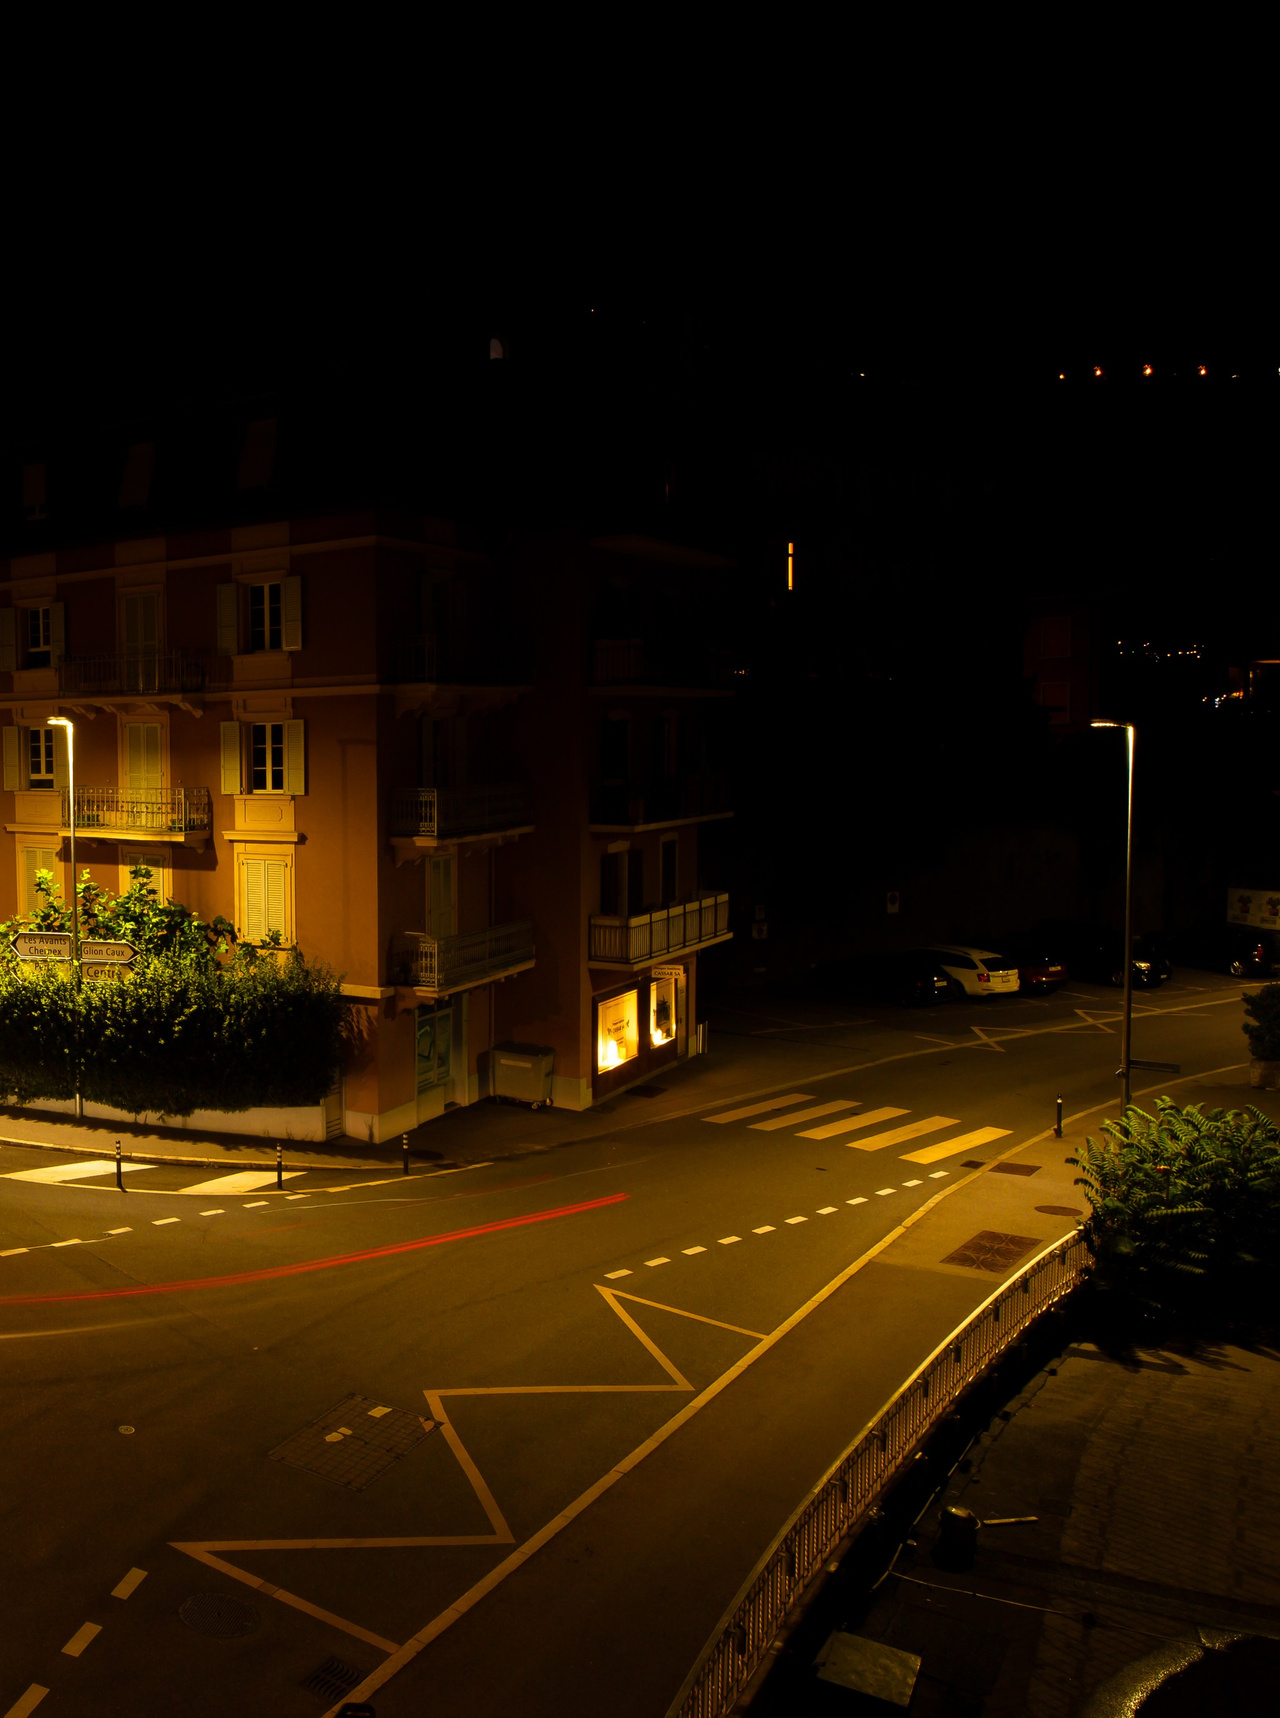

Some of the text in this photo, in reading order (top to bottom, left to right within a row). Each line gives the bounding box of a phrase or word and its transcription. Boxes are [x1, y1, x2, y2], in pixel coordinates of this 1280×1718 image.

[23, 936, 67, 945] Les Avants
[83, 946, 125, 957] Glion Caux
